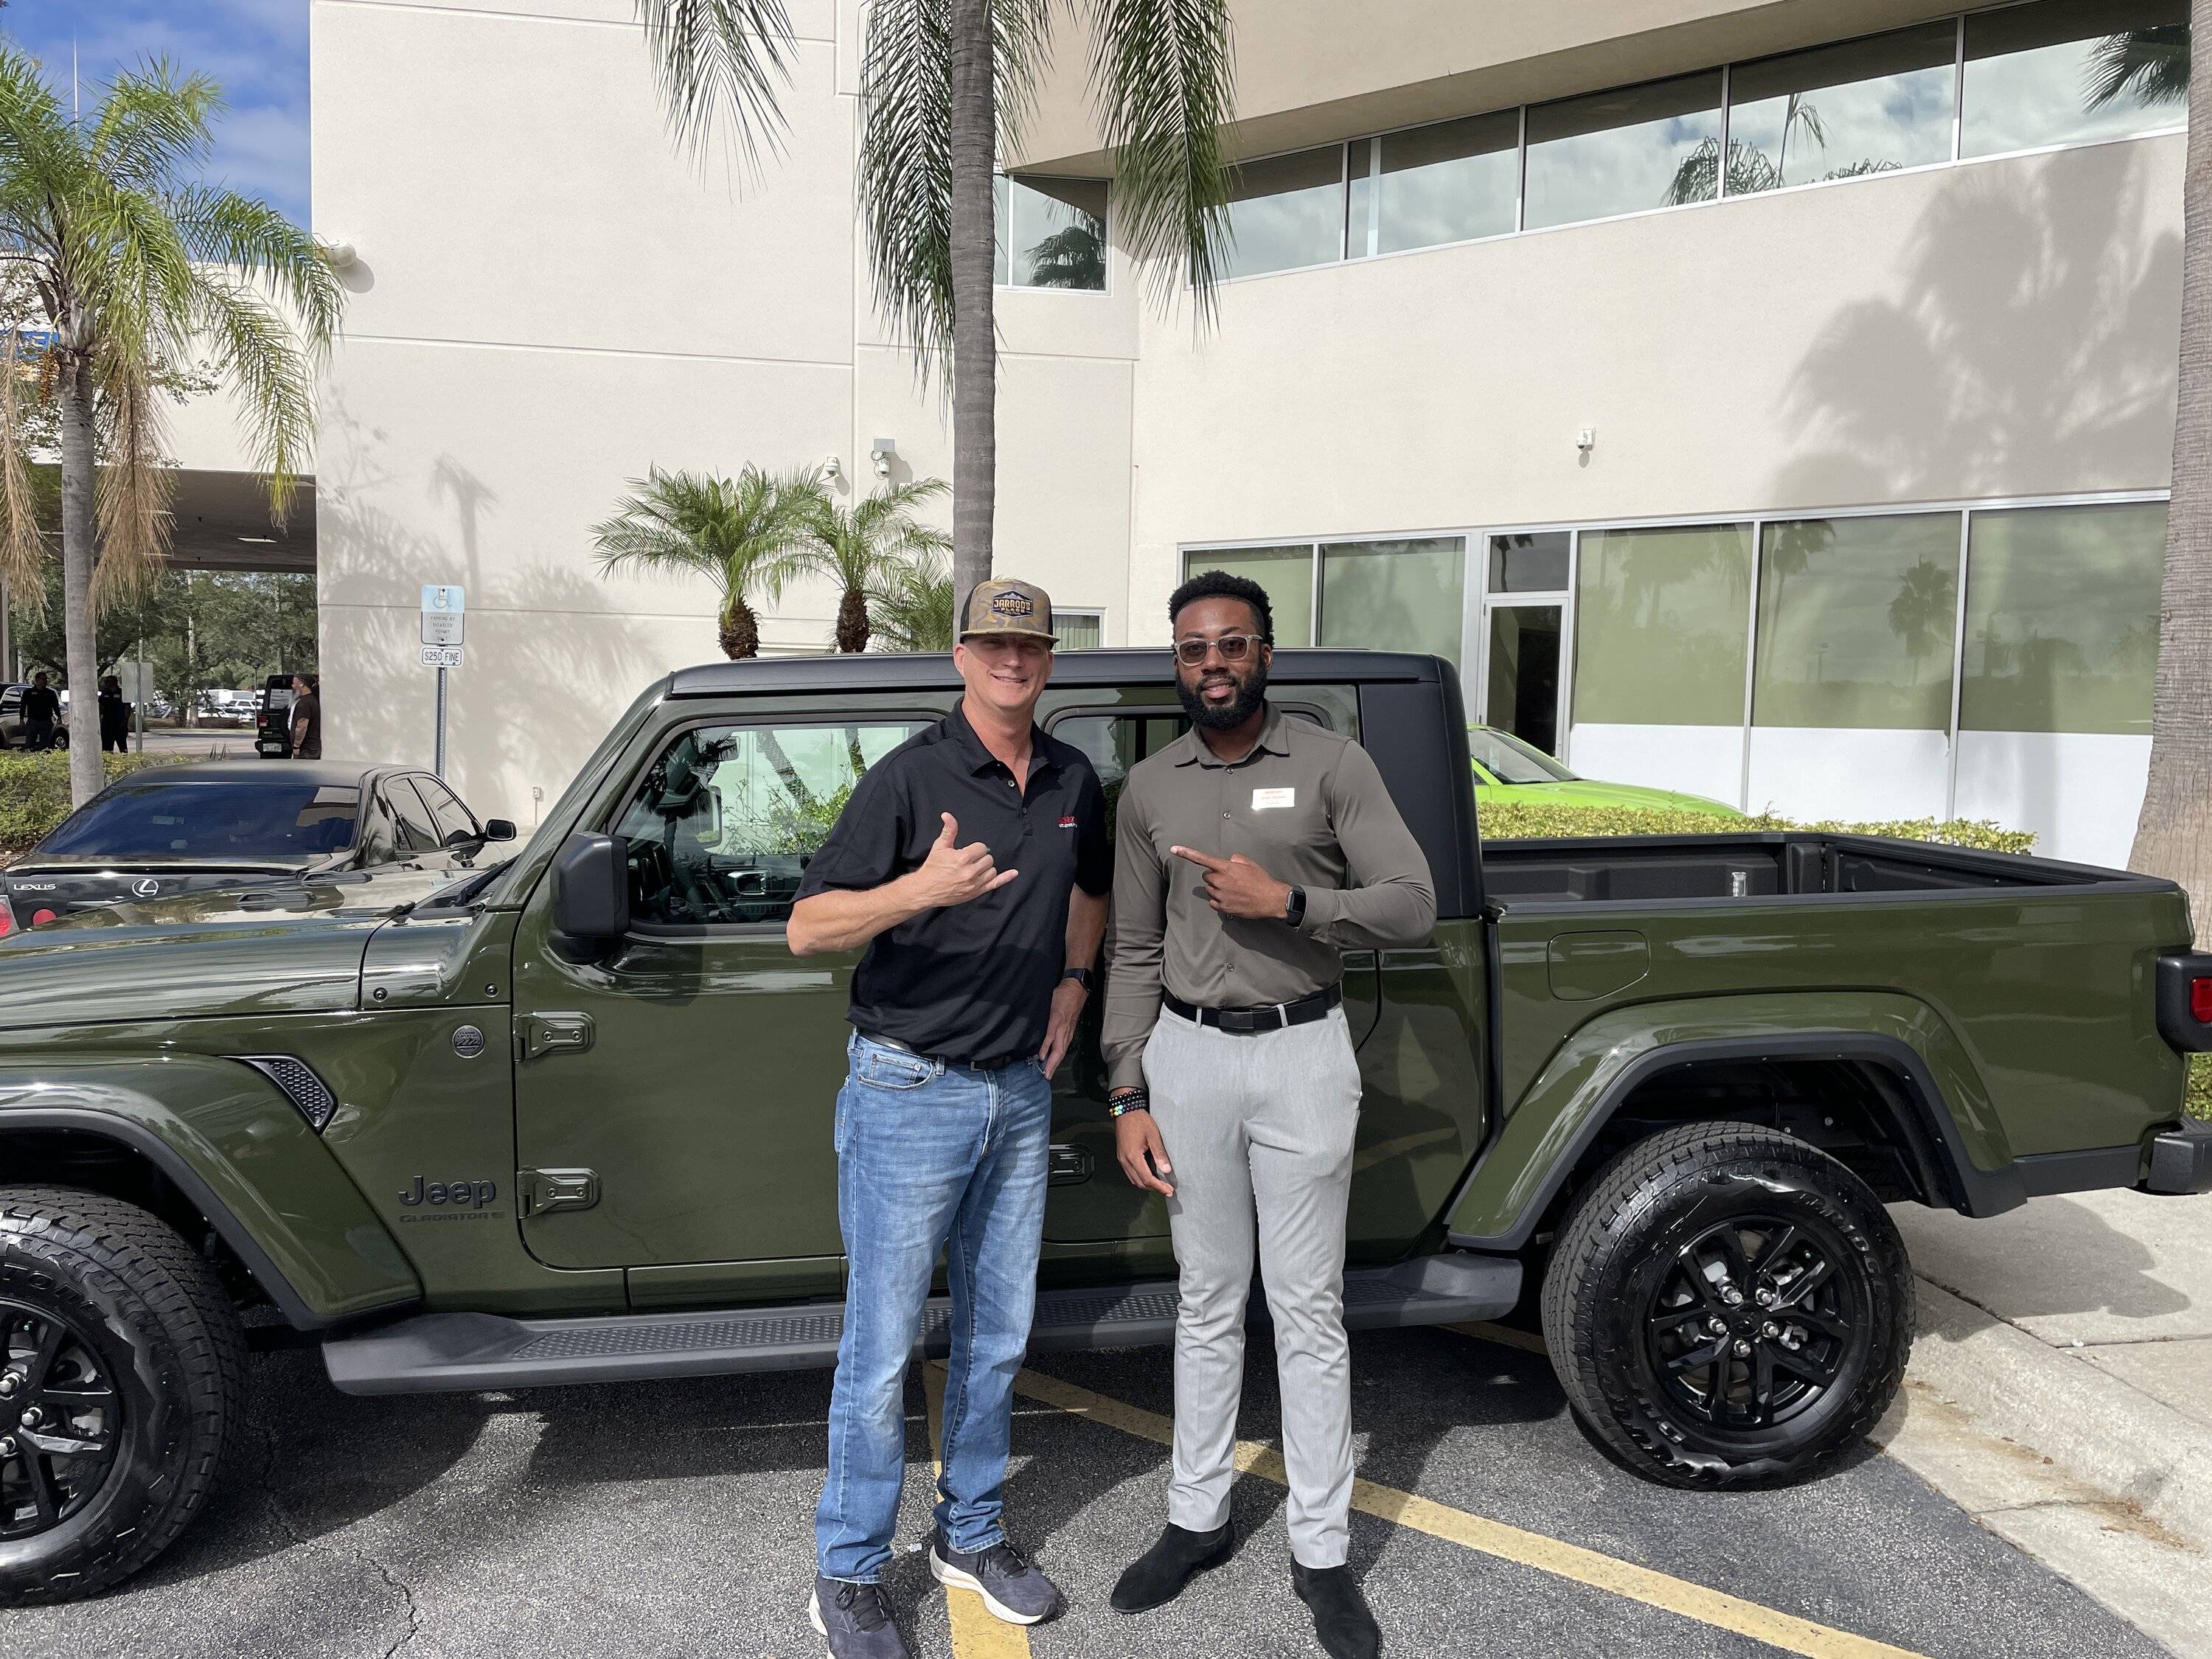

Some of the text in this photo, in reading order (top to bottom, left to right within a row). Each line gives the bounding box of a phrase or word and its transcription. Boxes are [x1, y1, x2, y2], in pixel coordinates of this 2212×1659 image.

[993, 599, 1031, 611] JARROD'S
[425, 651, 459, 662] $250 FINE
[13, 883, 57, 891] LEXUS
[398, 1174, 496, 1209] Jeep
